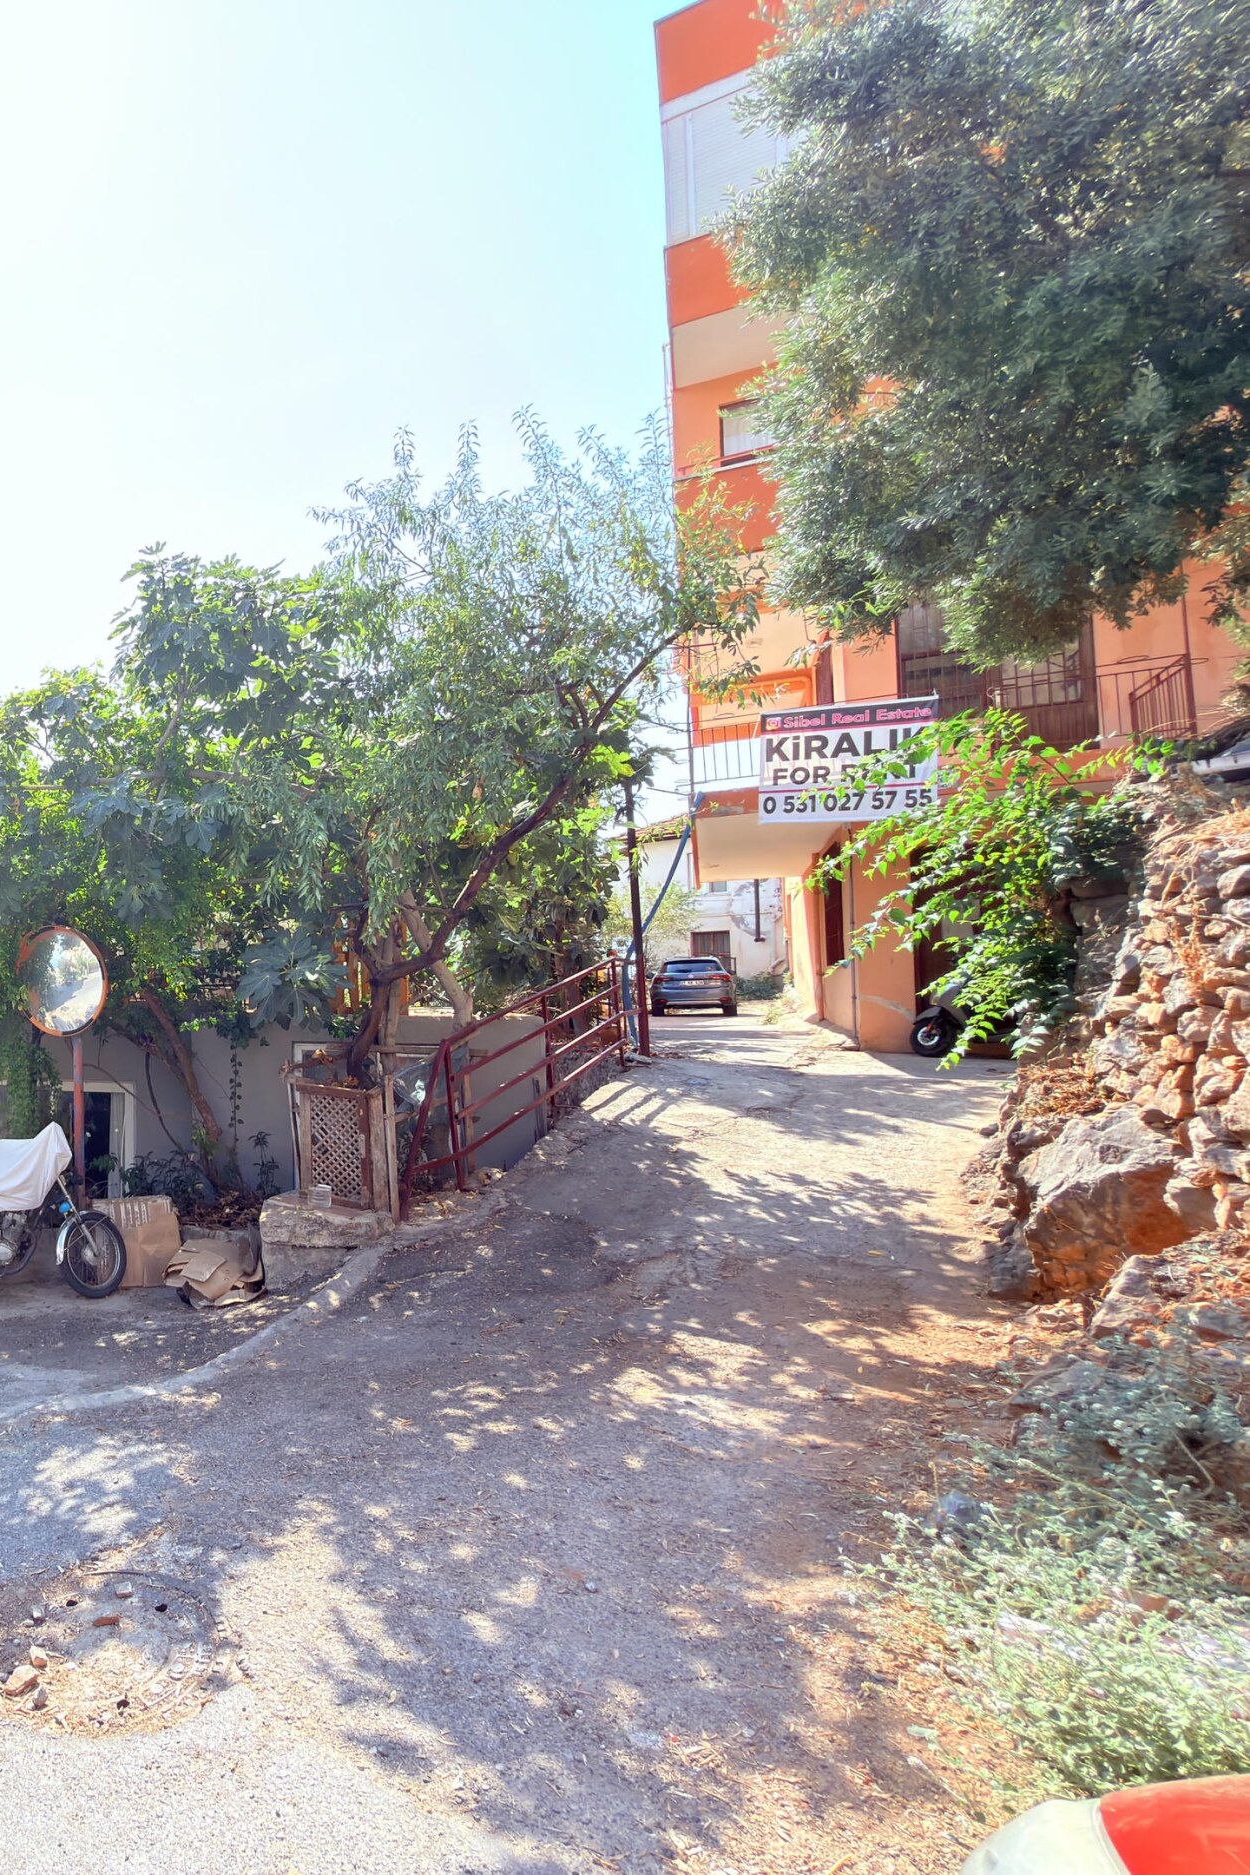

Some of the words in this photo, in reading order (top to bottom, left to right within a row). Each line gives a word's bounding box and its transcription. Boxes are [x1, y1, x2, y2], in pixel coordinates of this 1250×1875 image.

[783, 713, 826, 729] Sibel
[832, 709, 870, 724] Real
[876, 706, 932, 721] Estate
[772, 765, 831, 786] FOR
[841, 760, 918, 783] RT
[763, 796, 776, 814] 0
[783, 793, 816, 813] 531
[823, 792, 865, 812] 027
[871, 790, 898, 810] 57
[904, 788, 932, 808] 55
